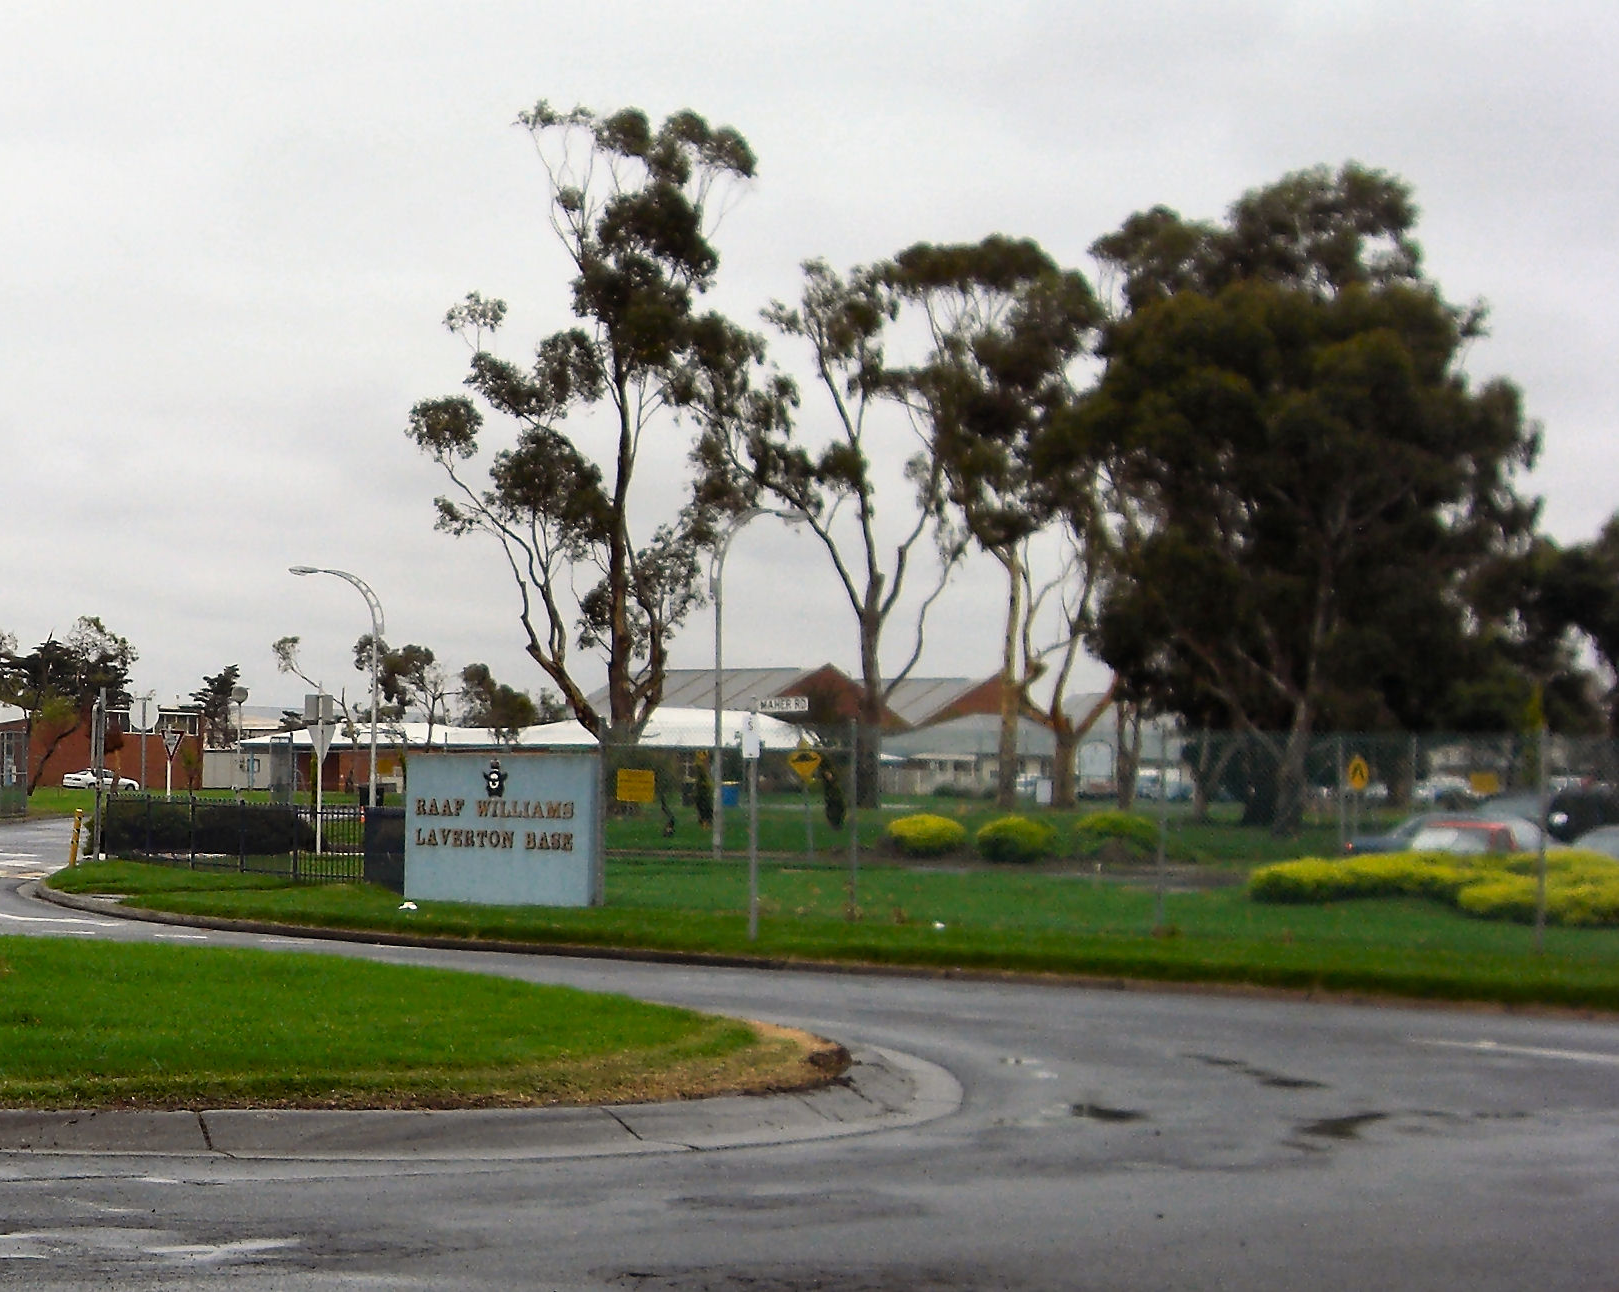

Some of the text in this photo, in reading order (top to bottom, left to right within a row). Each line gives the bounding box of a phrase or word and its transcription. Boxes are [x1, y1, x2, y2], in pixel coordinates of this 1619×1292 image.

[760, 699, 792, 710] MAHER
[415, 798, 574, 819] RAAF WILLIAMS
[415, 828, 574, 852] LAVERTON BASE
